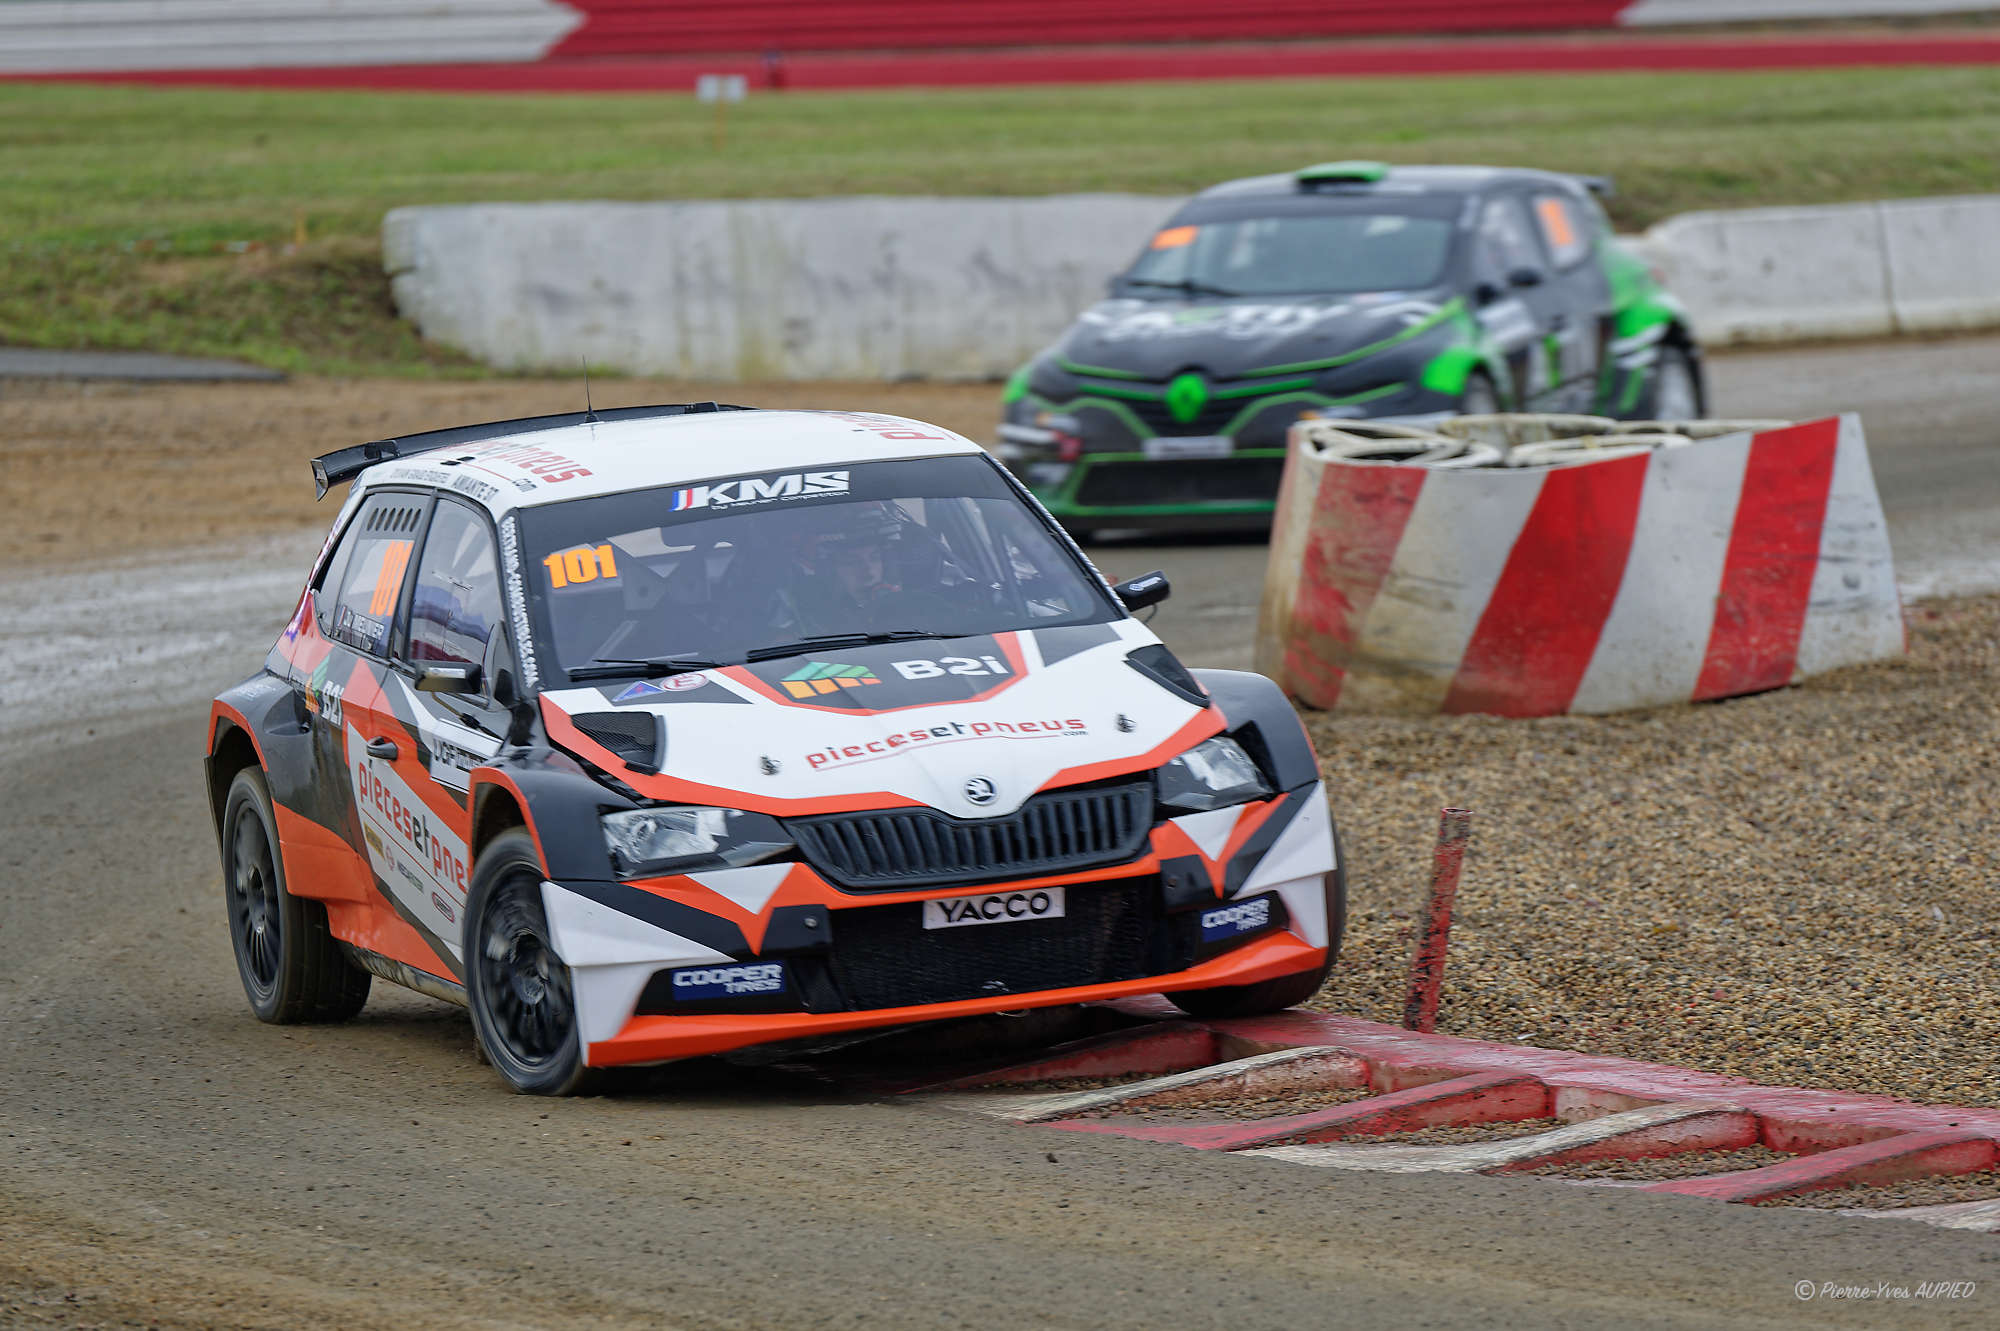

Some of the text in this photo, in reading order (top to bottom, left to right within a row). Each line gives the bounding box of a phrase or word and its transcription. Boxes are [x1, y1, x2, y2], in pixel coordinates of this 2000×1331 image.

[543, 544, 618, 589] 101
[890, 655, 1009, 680] B2i
[805, 718, 1086, 768] piecesetpneus
[358, 759, 471, 897] piecesetpne
[936, 892, 1050, 923] YACCO
[1202, 898, 1270, 929] COOPER
[1236, 914, 1269, 931] TIRES
[673, 964, 782, 987] COOPER
[723, 979, 782, 993] TIRES
